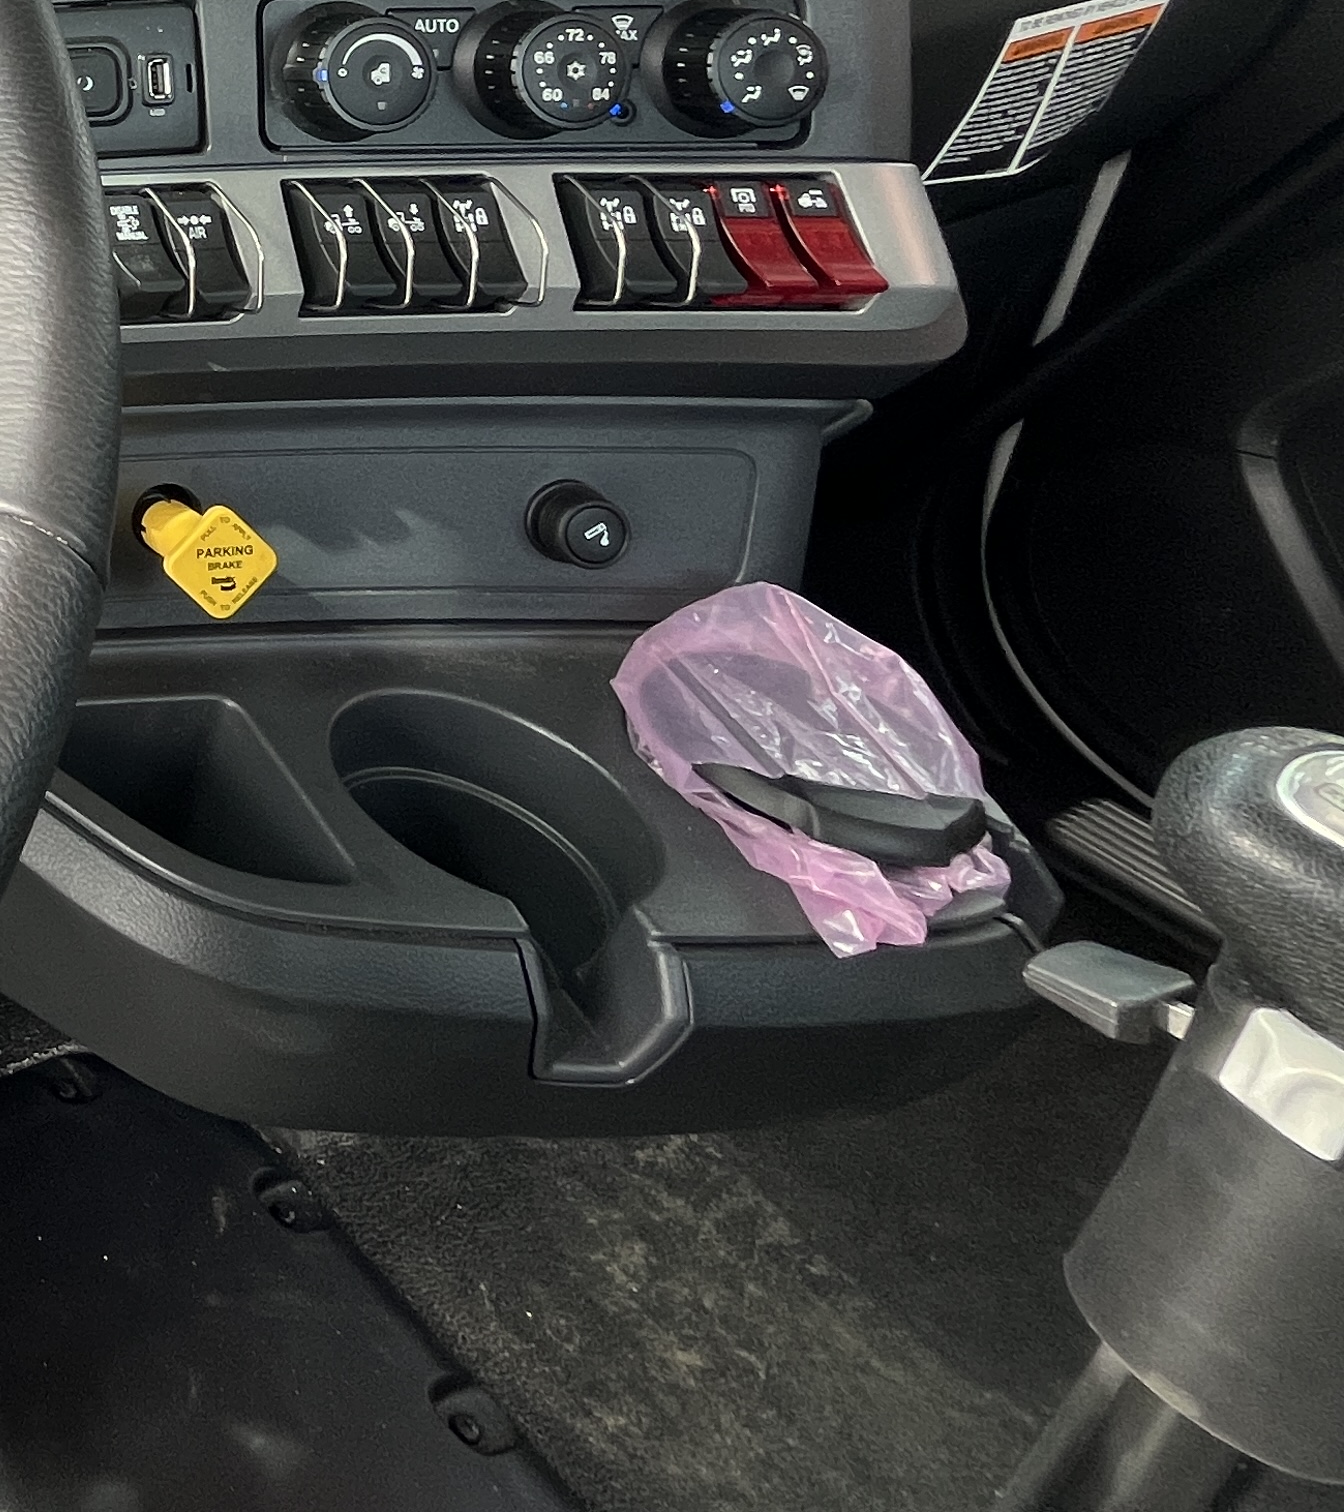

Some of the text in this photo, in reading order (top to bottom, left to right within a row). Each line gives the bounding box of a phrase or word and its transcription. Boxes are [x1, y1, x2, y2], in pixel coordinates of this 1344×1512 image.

[414, 18, 459, 33] AUTO
[565, 28, 585, 42] 72
[615, 29, 638, 41] AX
[534, 51, 555, 64] 66
[598, 51, 617, 65] 78
[542, 88, 563, 101] 60
[592, 87, 610, 101] 84
[188, 226, 207, 239] AIR
[196, 544, 254, 559] PARKING
[207, 560, 243, 571] BRAKE
